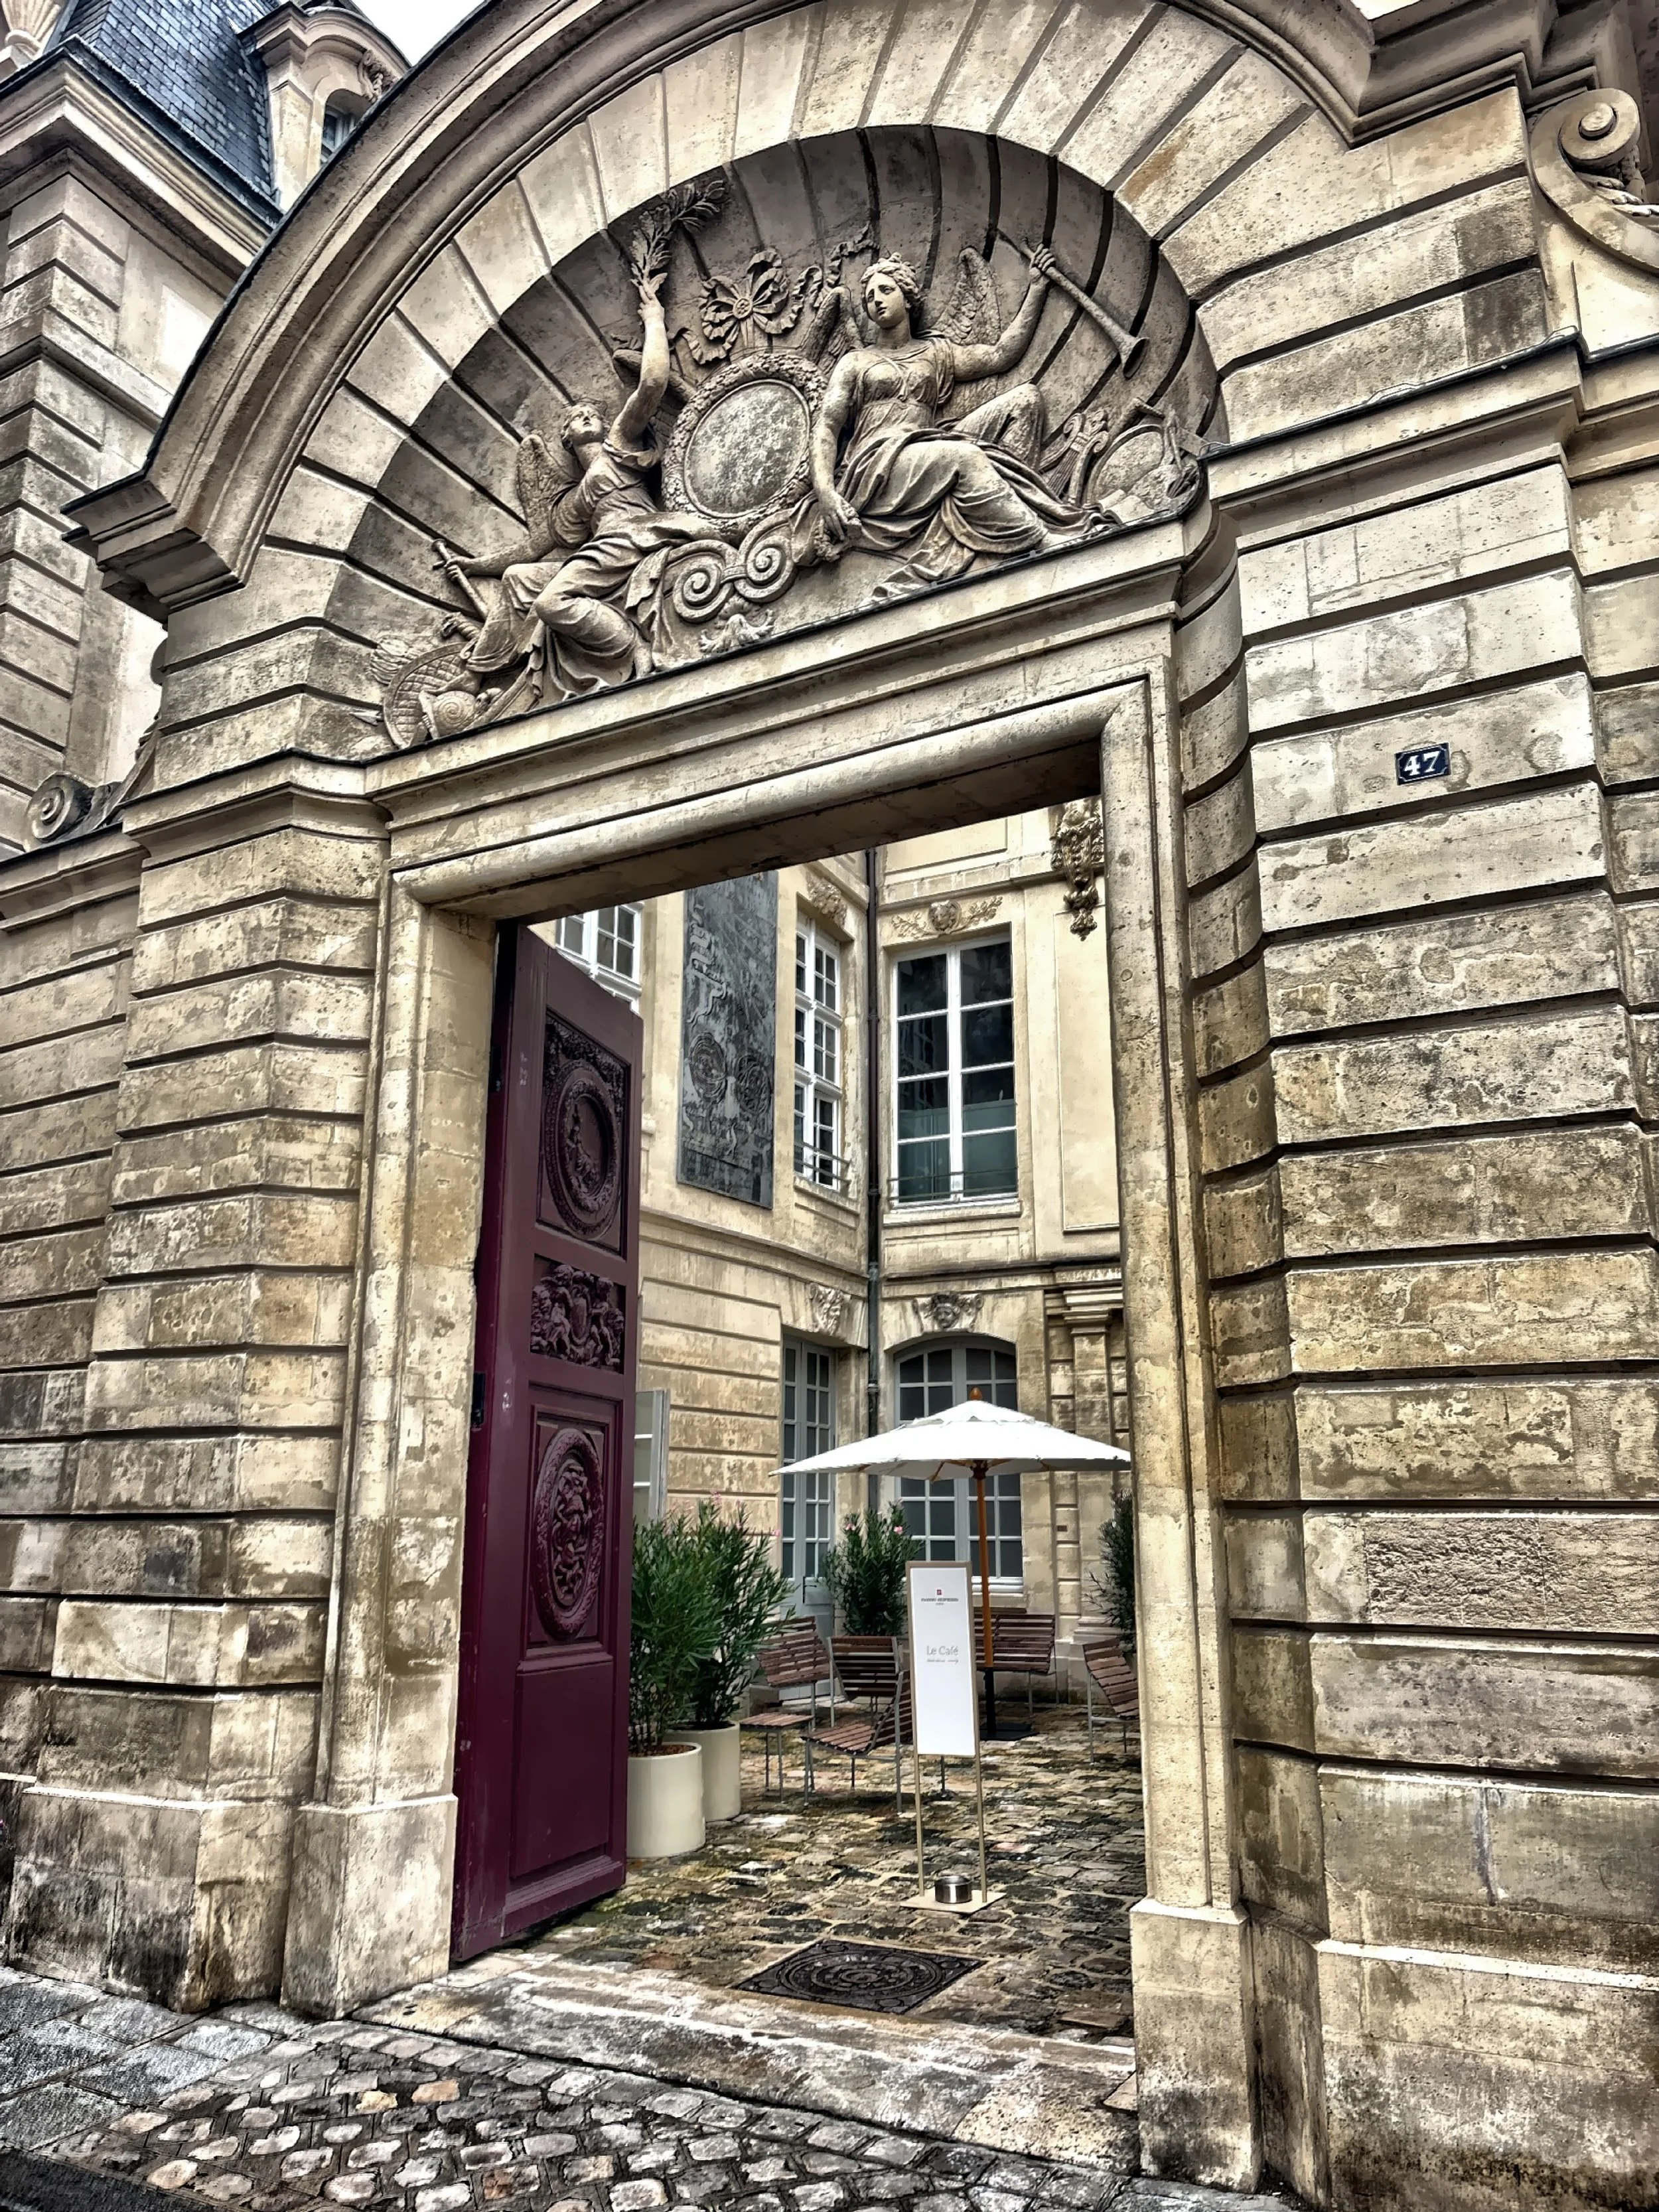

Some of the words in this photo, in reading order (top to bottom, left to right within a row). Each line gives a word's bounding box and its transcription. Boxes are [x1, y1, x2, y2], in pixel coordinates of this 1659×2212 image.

[1404, 751, 1441, 776] 47
[926, 1645, 937, 1655] Le
[938, 1645, 958, 1656] Café
